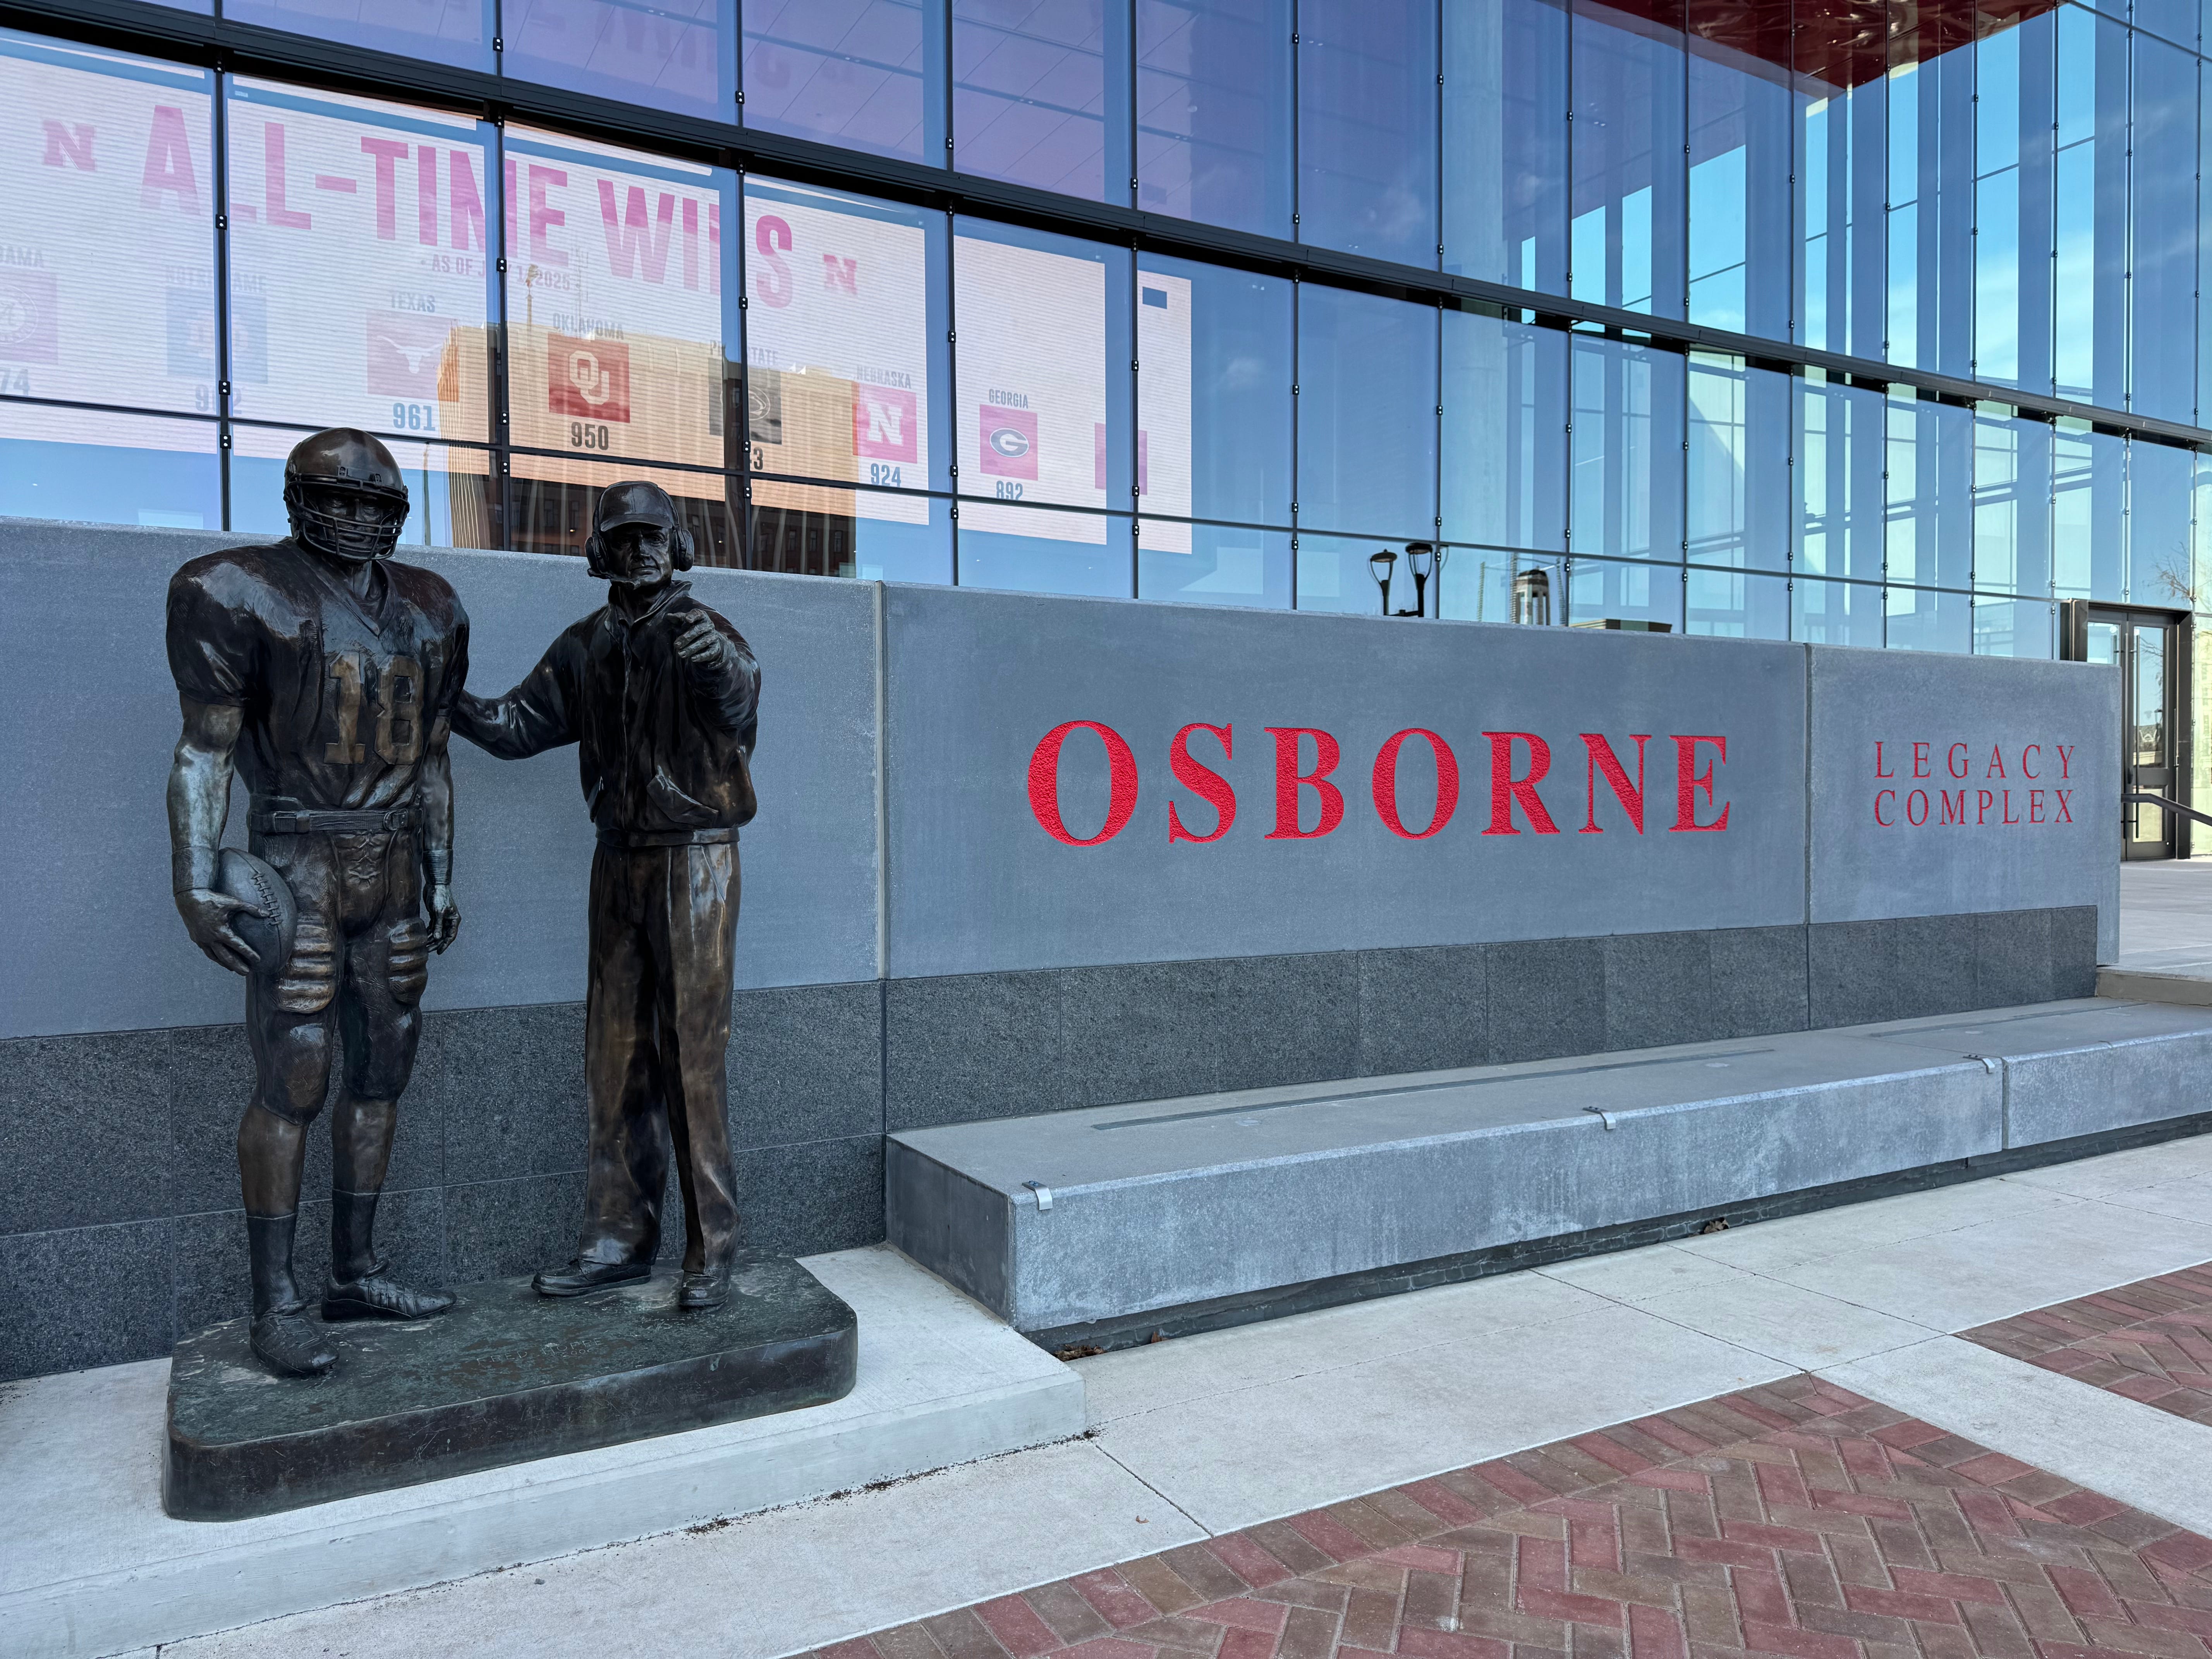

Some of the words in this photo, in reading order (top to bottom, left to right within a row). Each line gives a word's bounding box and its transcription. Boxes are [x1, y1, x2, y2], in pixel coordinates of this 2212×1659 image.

[597, 179, 793, 309] WIS
[232, 272, 267, 291] AME
[431, 254, 451, 272] AS
[455, 256, 473, 275] OF
[535, 270, 570, 291] 2025
[391, 291, 436, 313] TEXAS
[552, 313, 624, 340] OKLAHOMA
[747, 345, 778, 366] TATE
[857, 366, 911, 389] NEBRASKA
[989, 388, 1029, 409] GEORGIA
[393, 402, 436, 431] 961
[571, 421, 609, 450] 950
[871, 463, 902, 488] 924
[996, 480, 1024, 501] 892
[323, 651, 424, 765] 18
[1874, 741, 2075, 780] LEGACY
[1028, 720, 1730, 847] OSBORNE
[1874, 789, 2074, 827] COMPLEX
